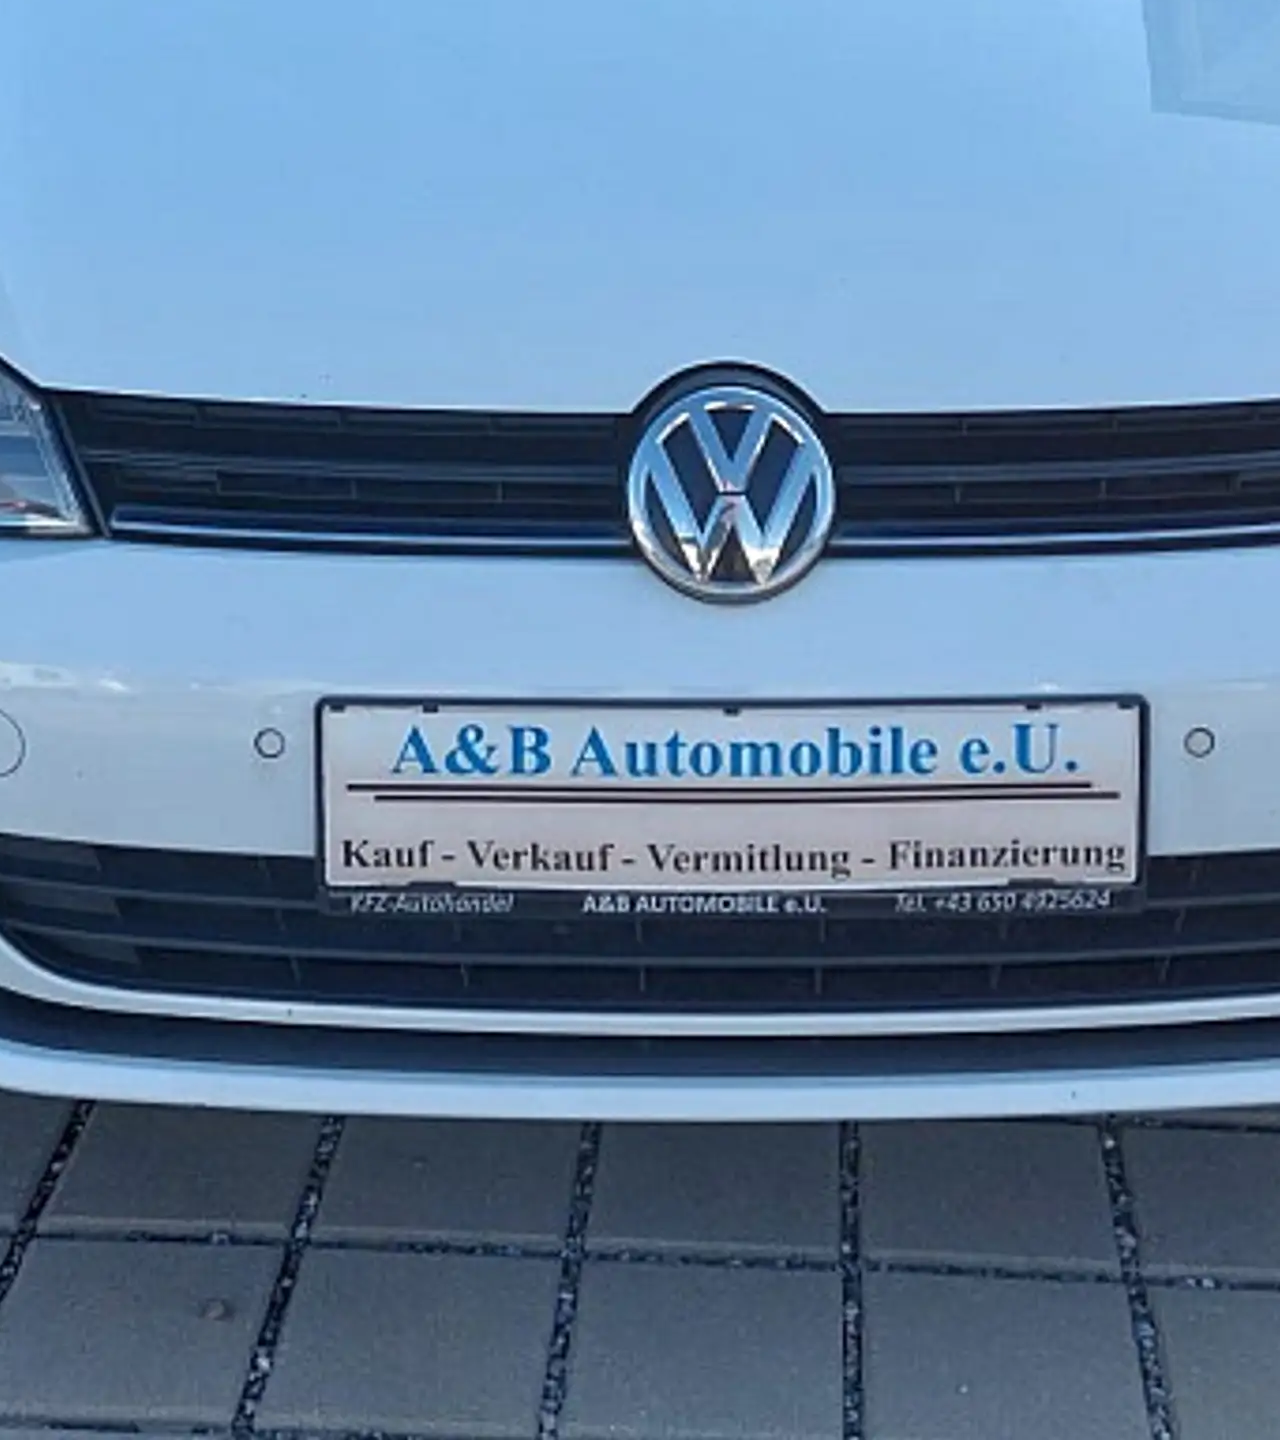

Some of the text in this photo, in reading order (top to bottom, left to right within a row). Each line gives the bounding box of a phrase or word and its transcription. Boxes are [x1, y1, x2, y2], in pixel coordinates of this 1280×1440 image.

[391, 723, 1079, 777] A&B Automobile e.U.
[341, 839, 435, 868] Kauf
[466, 841, 616, 871] Verkauf
[646, 843, 852, 879] Vermitlung
[888, 839, 1126, 873] Finanzierung
[582, 893, 630, 913] A&B
[635, 894, 780, 913] AUTOMOBILE
